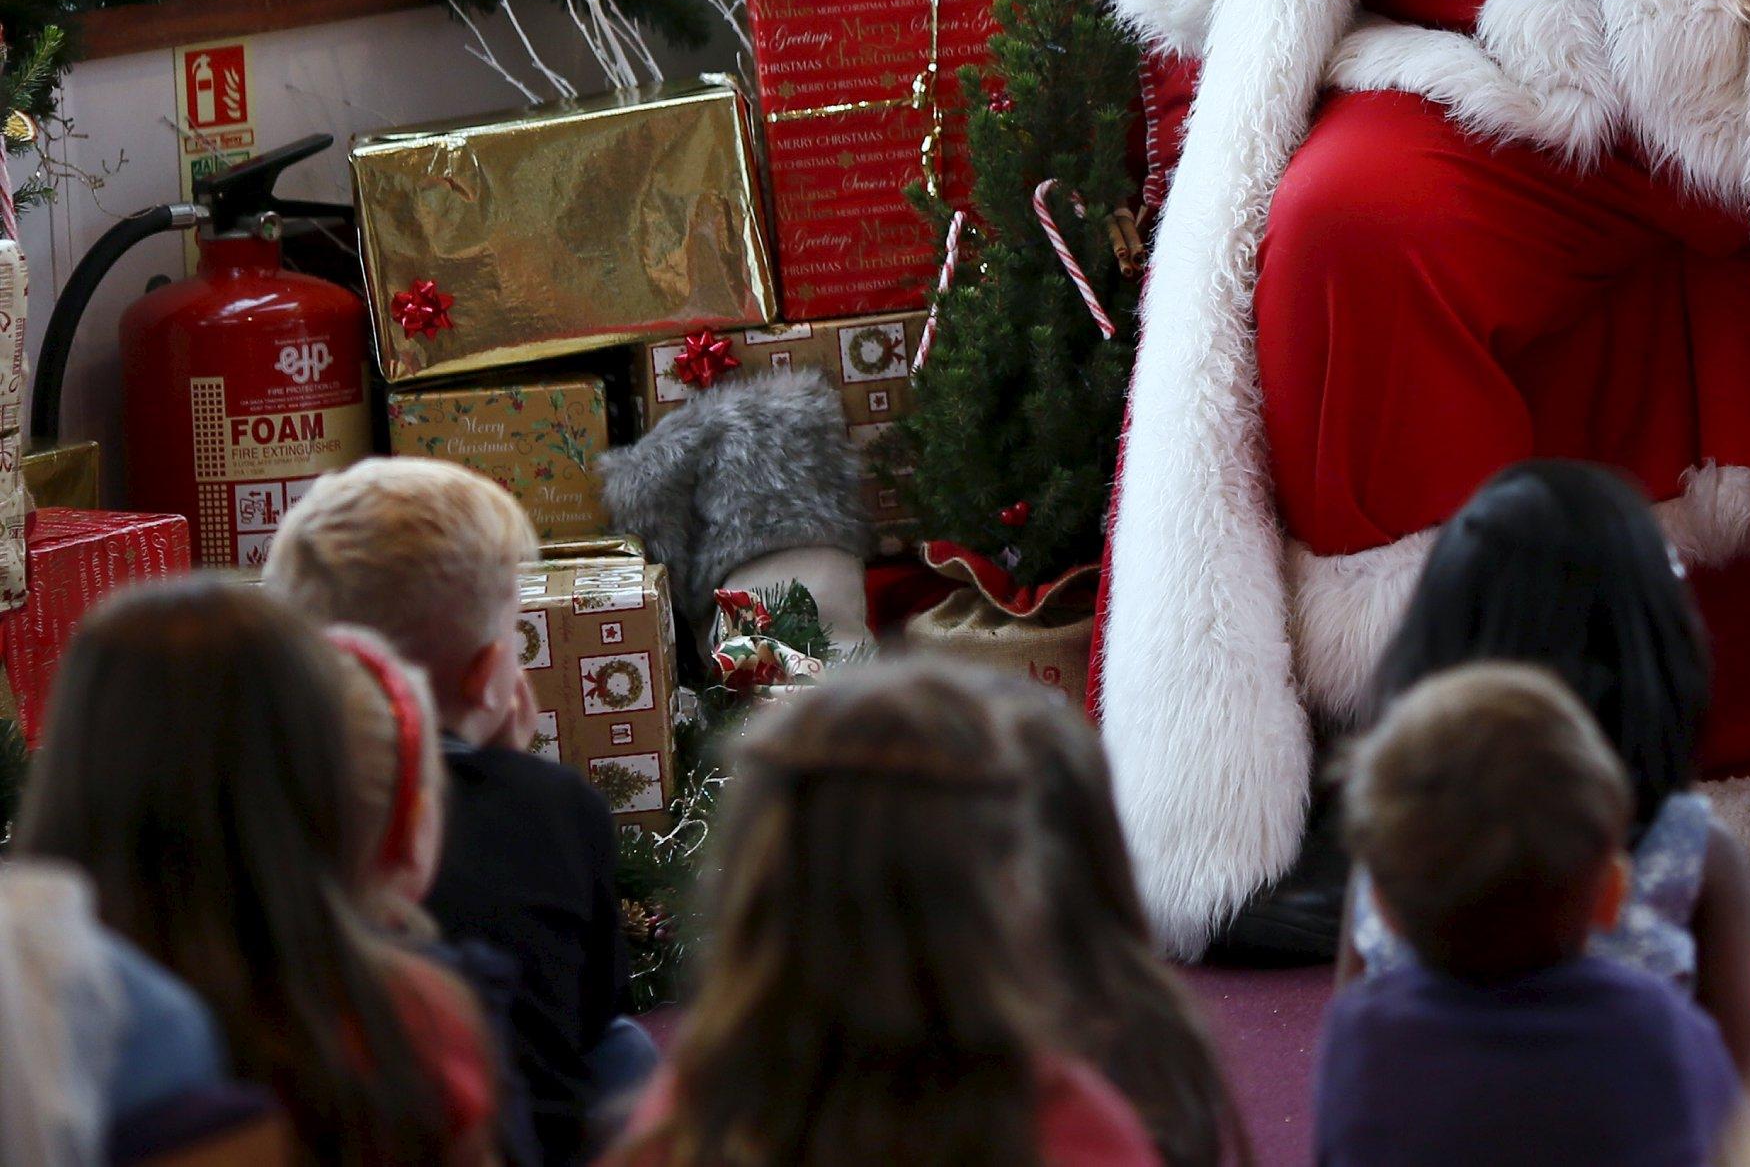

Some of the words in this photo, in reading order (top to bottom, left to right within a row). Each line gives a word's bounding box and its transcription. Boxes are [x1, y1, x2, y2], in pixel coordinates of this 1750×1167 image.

[842, 1, 889, 13] CHRISTMAS
[769, 24, 833, 52] Greetings
[841, 17, 901, 42] Merry
[797, 80, 825, 95] MERRY
[826, 76, 879, 90] CHRISTMAS
[777, 137, 815, 152] MERRY
[816, 131, 884, 147] CHRISTMAS
[784, 157, 836, 170] CHRISTMAS
[855, 153, 883, 165] MERRY
[841, 169, 898, 191] Season's
[789, 227, 853, 254] Greetings
[815, 283, 844, 295] MERRY
[845, 279, 893, 292] CHRISTMAS
[266, 386, 286, 396] FIRE
[230, 412, 325, 447] FOAM
[464, 416, 505, 439] Merry
[231, 447, 259, 460] FIRE
[262, 439, 342, 459] EXTINGUISHER
[447, 437, 516, 455] Christmas
[542, 485, 583, 508] Merry
[91, 551, 103, 588] MERRY
